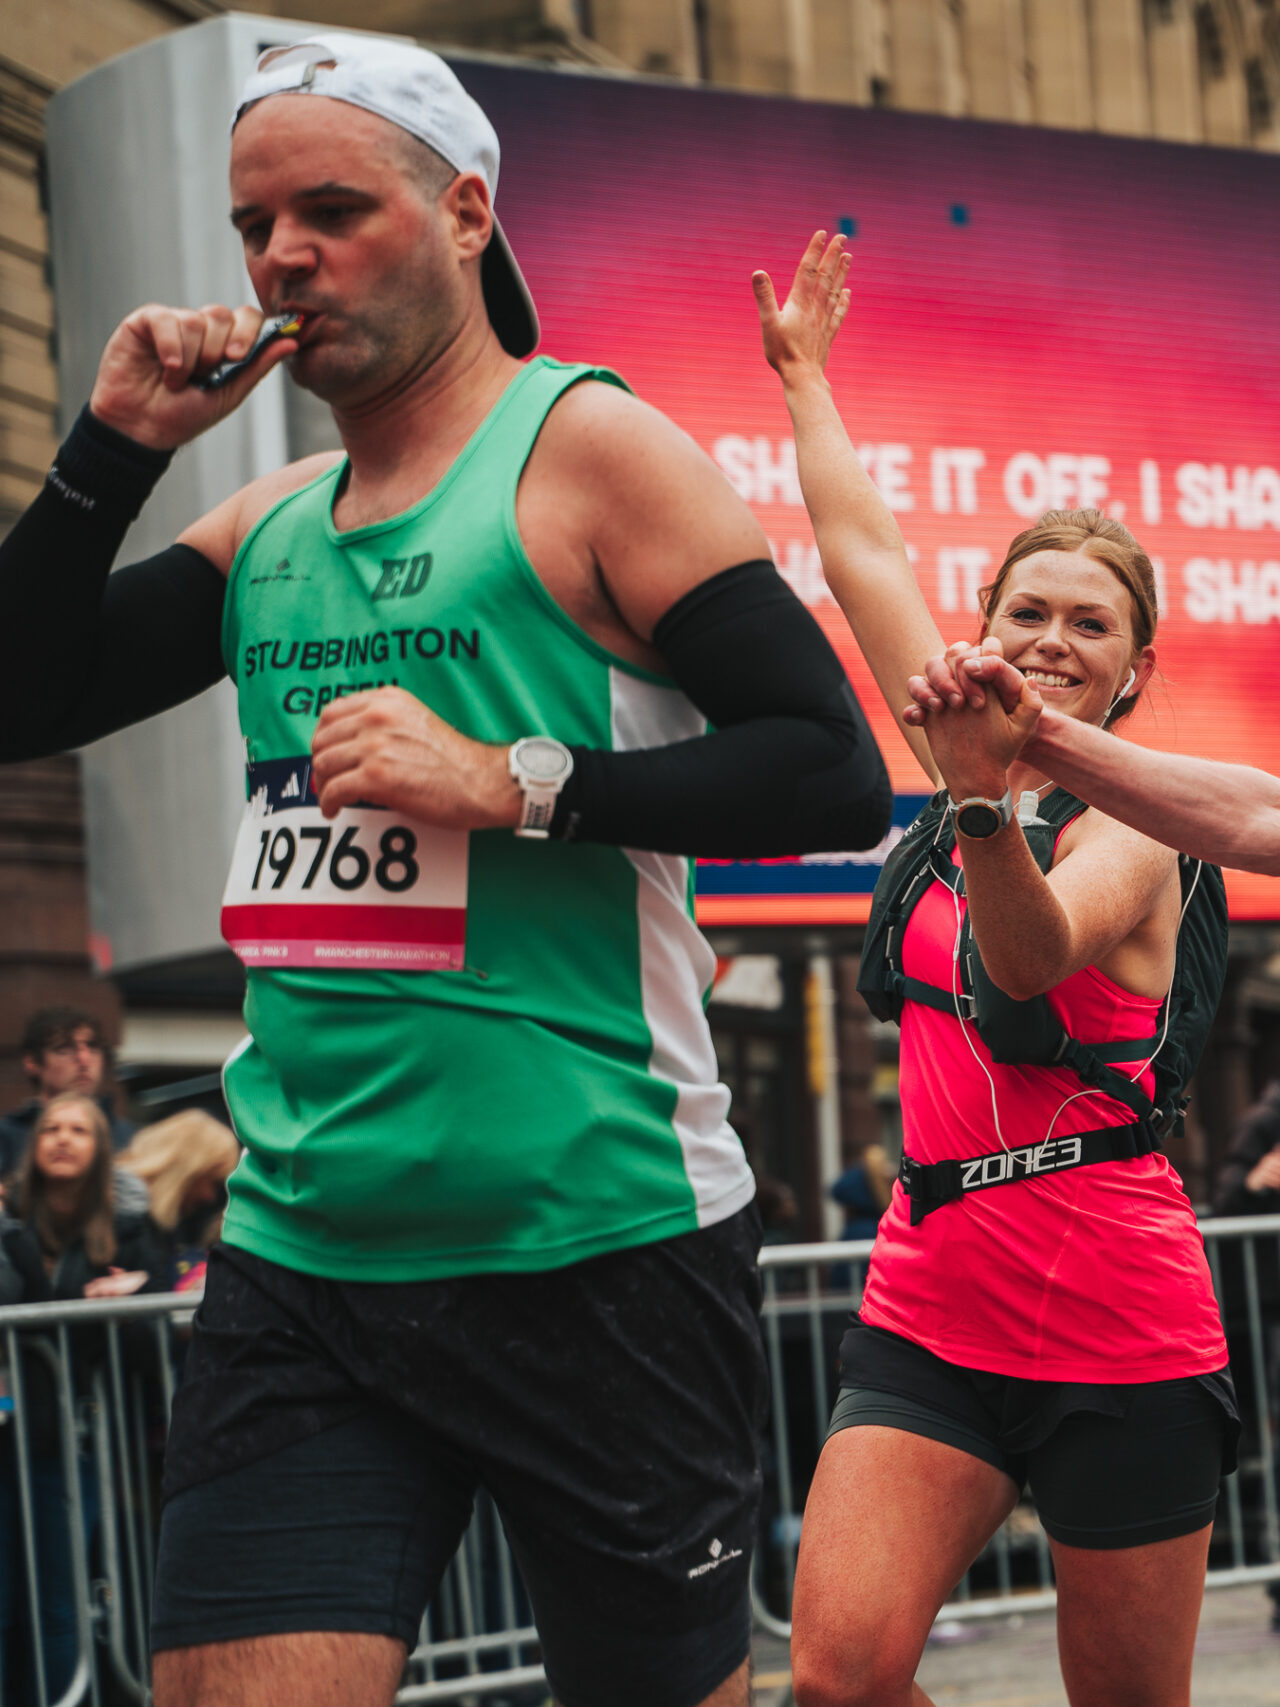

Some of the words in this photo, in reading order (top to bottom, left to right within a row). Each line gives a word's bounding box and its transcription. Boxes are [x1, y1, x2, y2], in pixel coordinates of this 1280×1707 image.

[930, 447, 985, 515] IT
[1141, 459, 1161, 525] I
[371, 552, 433, 602] ED
[937, 546, 993, 614] IT
[244, 627, 481, 678] STUBBINGTON
[251, 826, 420, 893] 19768
[960, 1137, 1082, 1189] ZONE3
